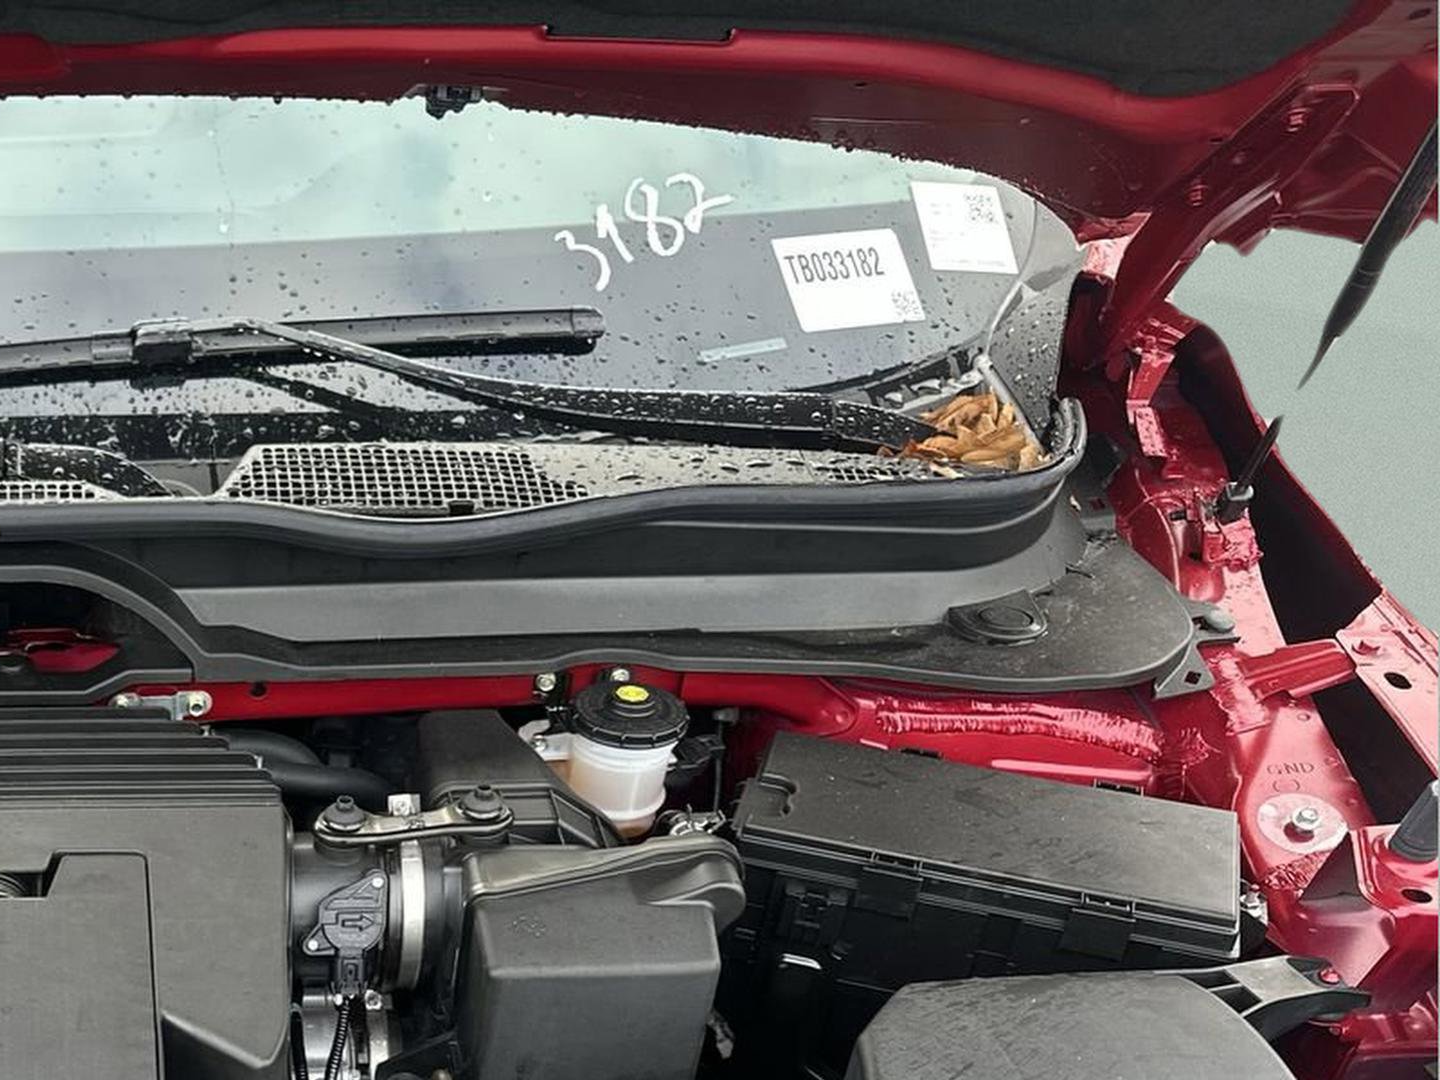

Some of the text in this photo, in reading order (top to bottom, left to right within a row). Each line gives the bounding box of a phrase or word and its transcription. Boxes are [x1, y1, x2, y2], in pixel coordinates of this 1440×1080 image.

[555, 173, 734, 291] 3182
[783, 247, 885, 284] TB033182
[1266, 762, 1315, 775] GND
